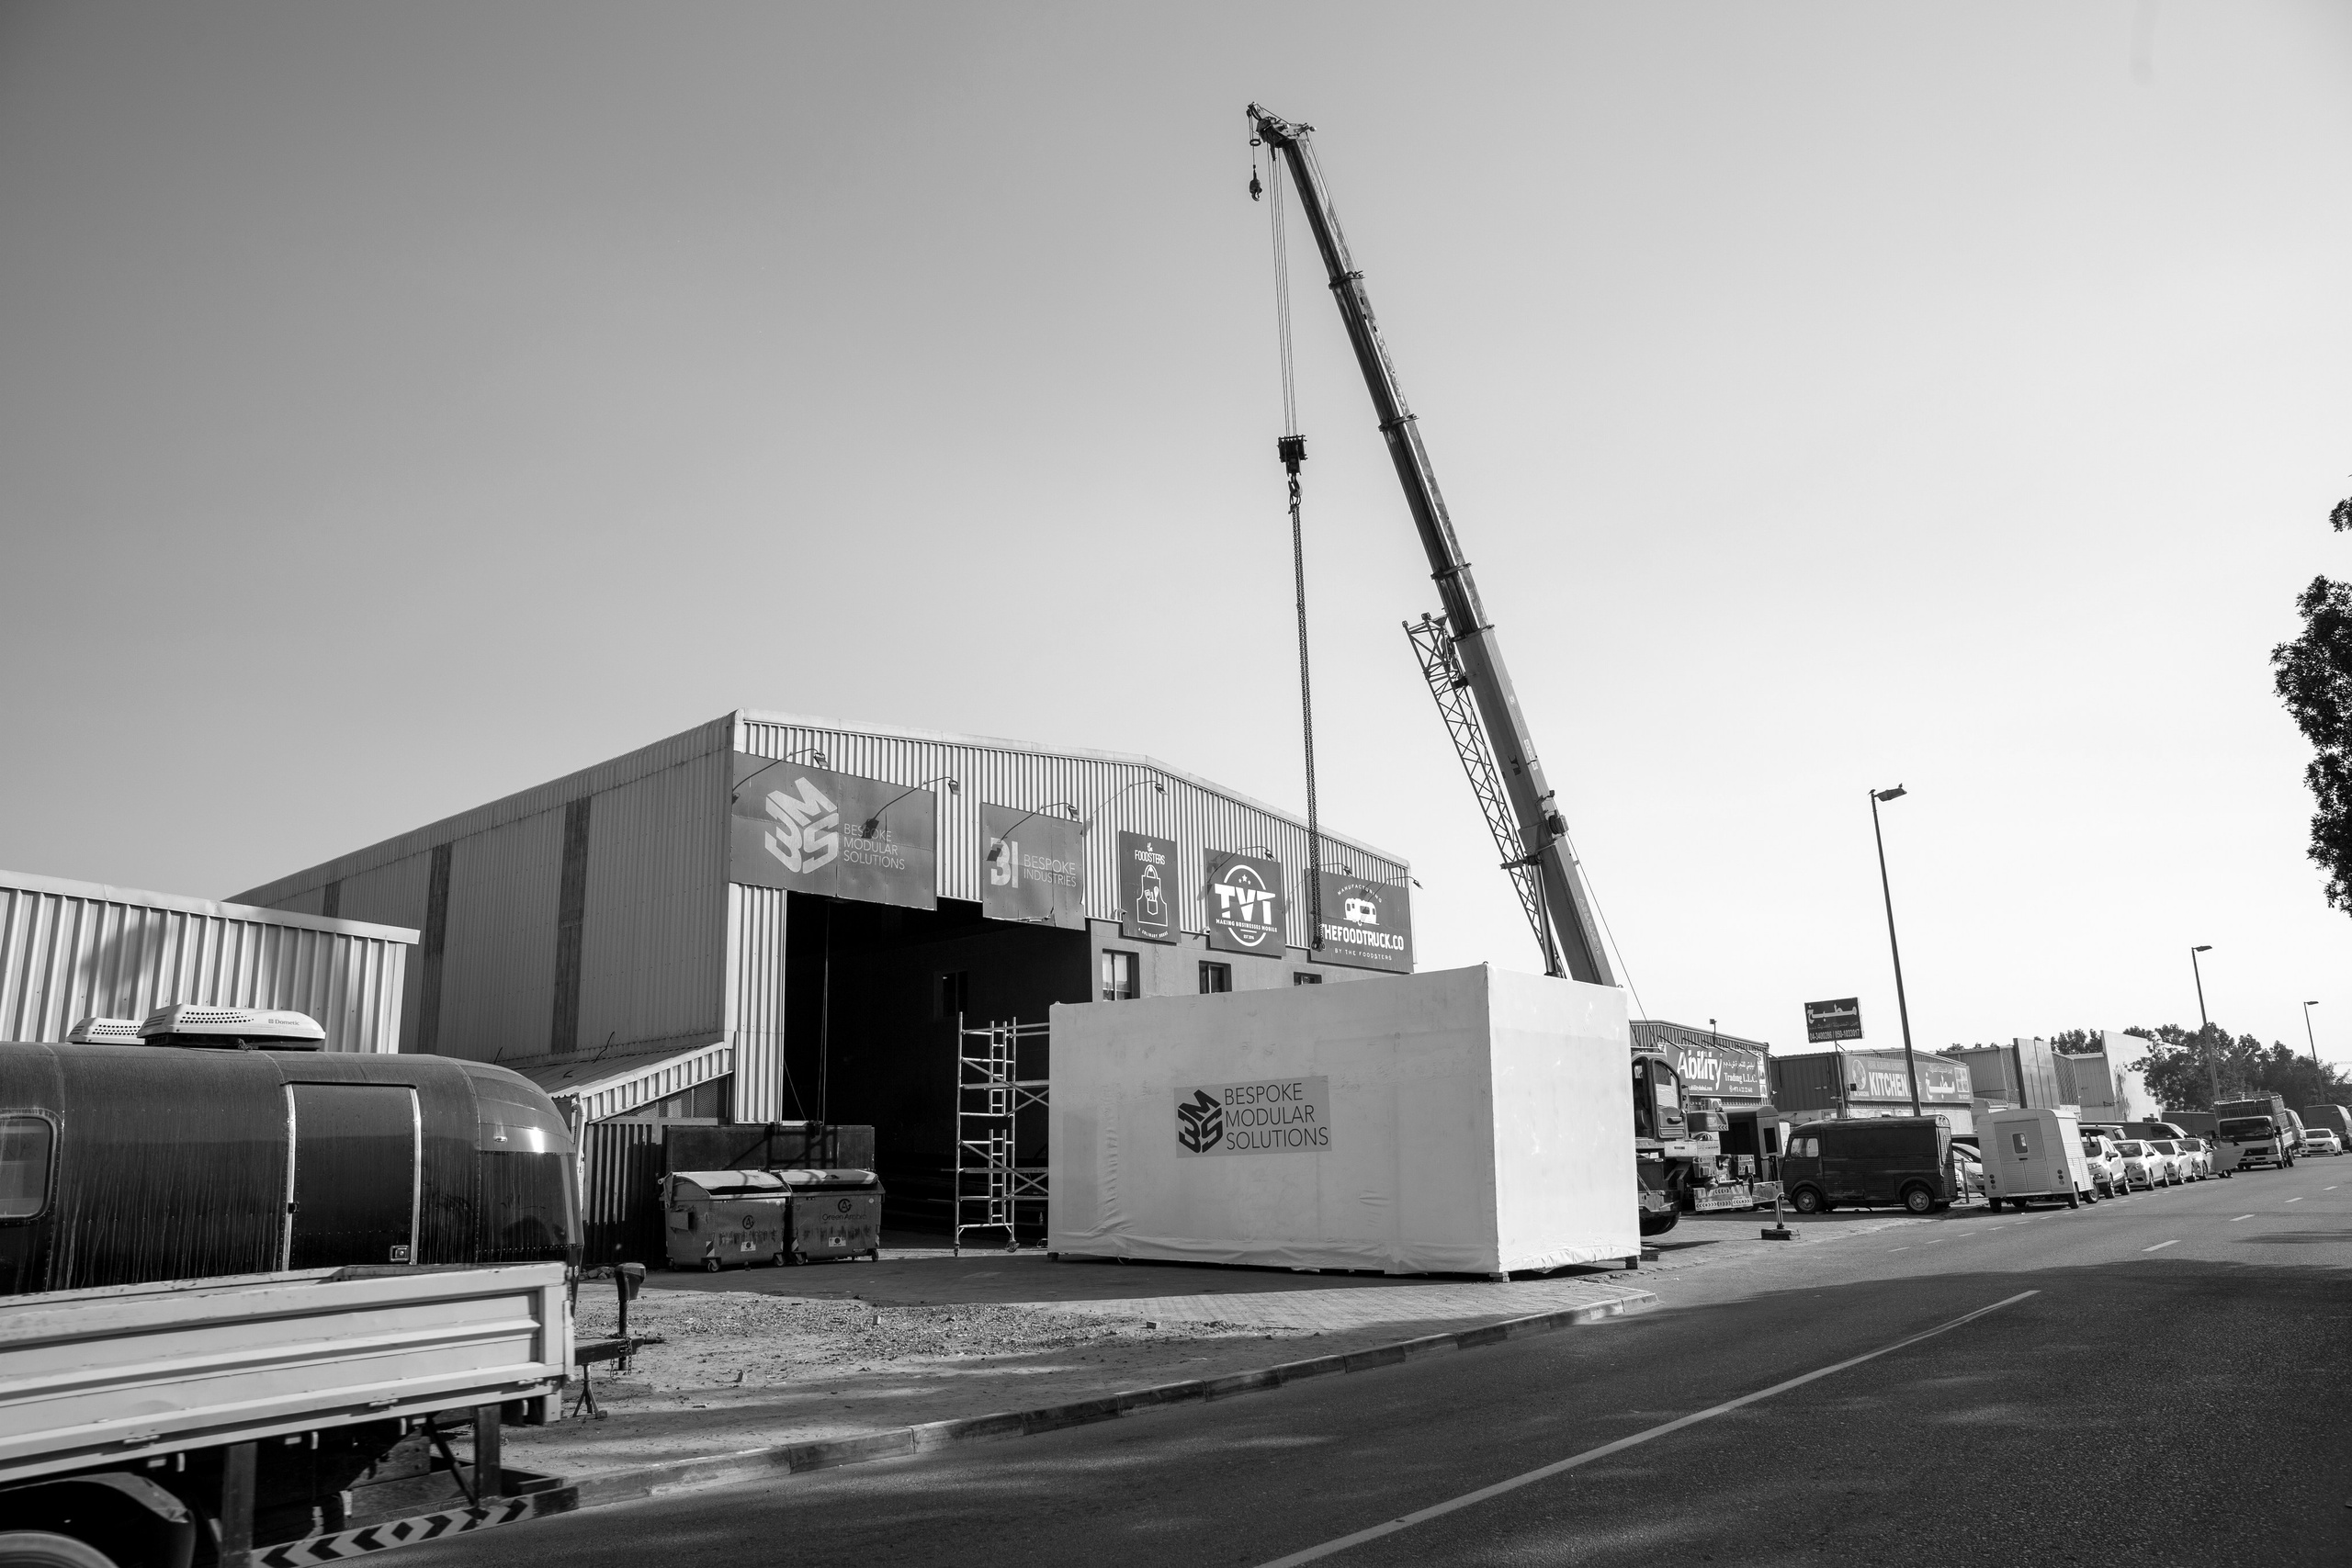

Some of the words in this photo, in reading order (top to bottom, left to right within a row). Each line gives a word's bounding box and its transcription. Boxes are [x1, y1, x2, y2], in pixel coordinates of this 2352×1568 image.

[843, 823, 892, 842] BESPOKE
[843, 836, 899, 856] MODULAR
[843, 850, 905, 870] SOLUTIONS
[1023, 853, 1076, 875] BESPOKE
[1134, 849, 1166, 865] FOODSTERS
[1023, 868, 1077, 887] INDUSTRIES
[1214, 883, 1276, 926] TVT
[1216, 918, 1236, 927] MAKING
[1236, 920, 1261, 931] BUSINESSES
[1261, 924, 1278, 933] MOBILE
[1359, 950, 1393, 962] FOODSTERS
[1806, 1003, 1857, 1024] مطبخ
[1677, 1049, 1723, 1091] Ability
[1724, 1072, 1743, 1085] Trading
[1224, 1082, 1304, 1106] BESPOKE
[1868, 1071, 1909, 1098] KITCHEN
[1925, 1071, 1956, 1100] مطبخ
[1225, 1104, 1316, 1128] MODULAR
[1226, 1126, 1329, 1150] SOLUTIONS
